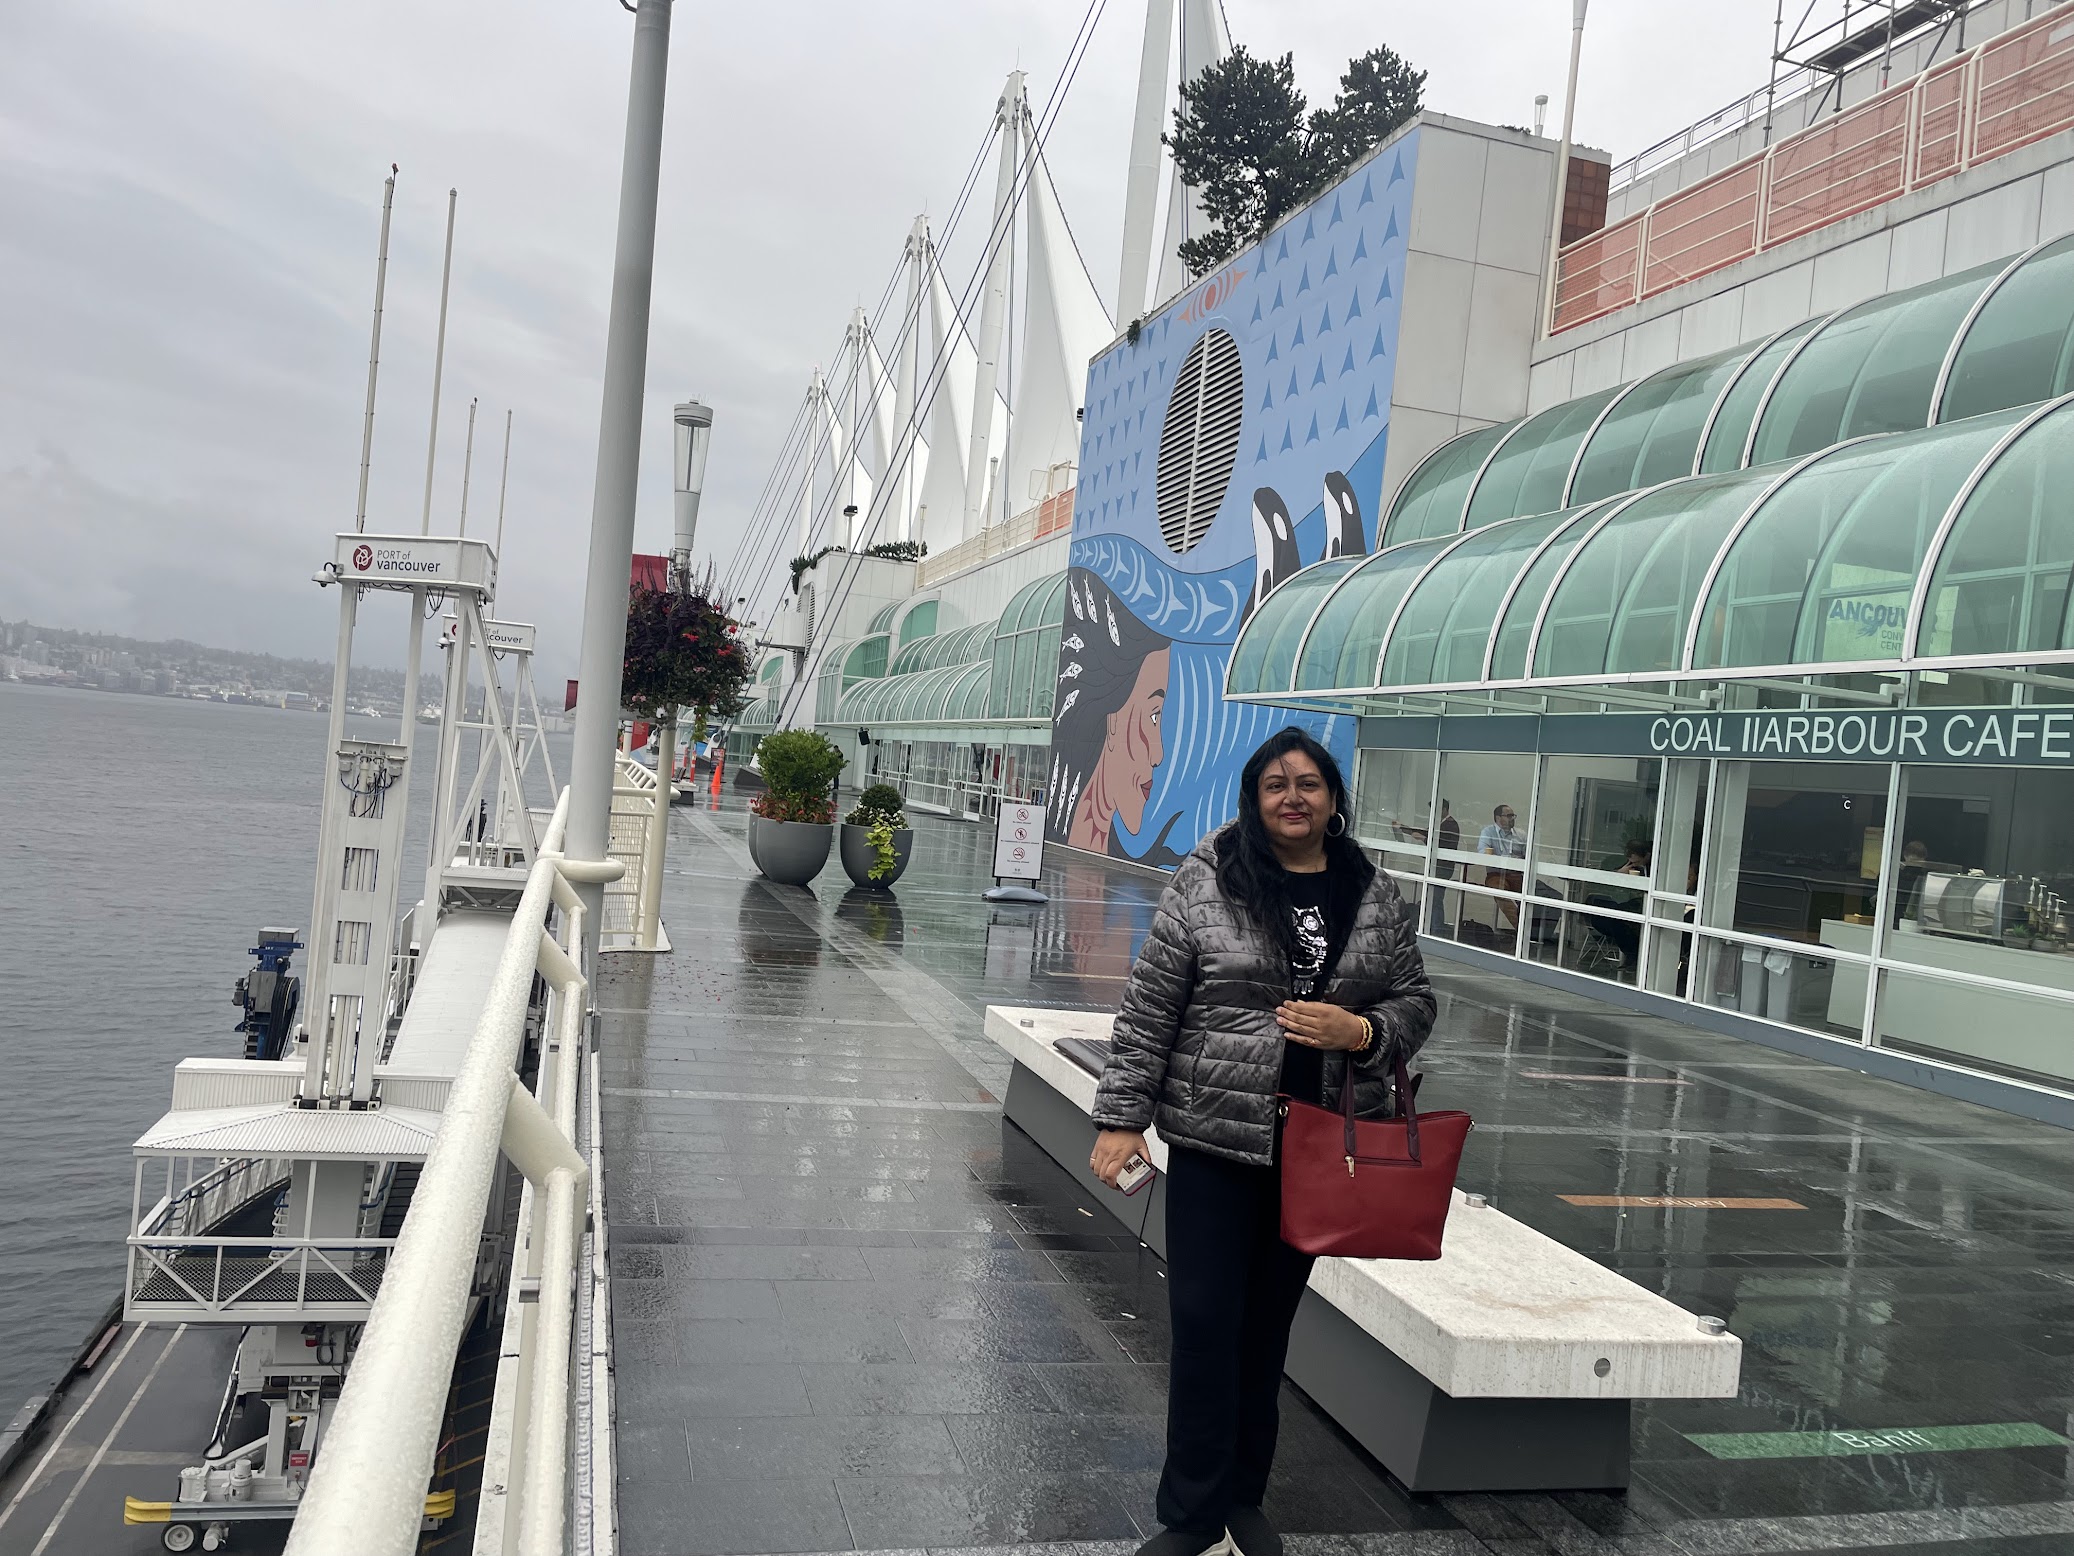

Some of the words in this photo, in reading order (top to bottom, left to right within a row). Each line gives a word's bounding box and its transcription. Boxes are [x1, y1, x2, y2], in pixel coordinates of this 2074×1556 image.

[377, 549, 401, 560] PORT
[402, 551, 411, 560] of
[377, 560, 441, 573] vancouver
[487, 634, 523, 644] couver
[1650, 717, 1731, 753] COAL
[1943, 714, 2073, 759] CAFE
[1832, 1430, 1932, 1447] Banff
